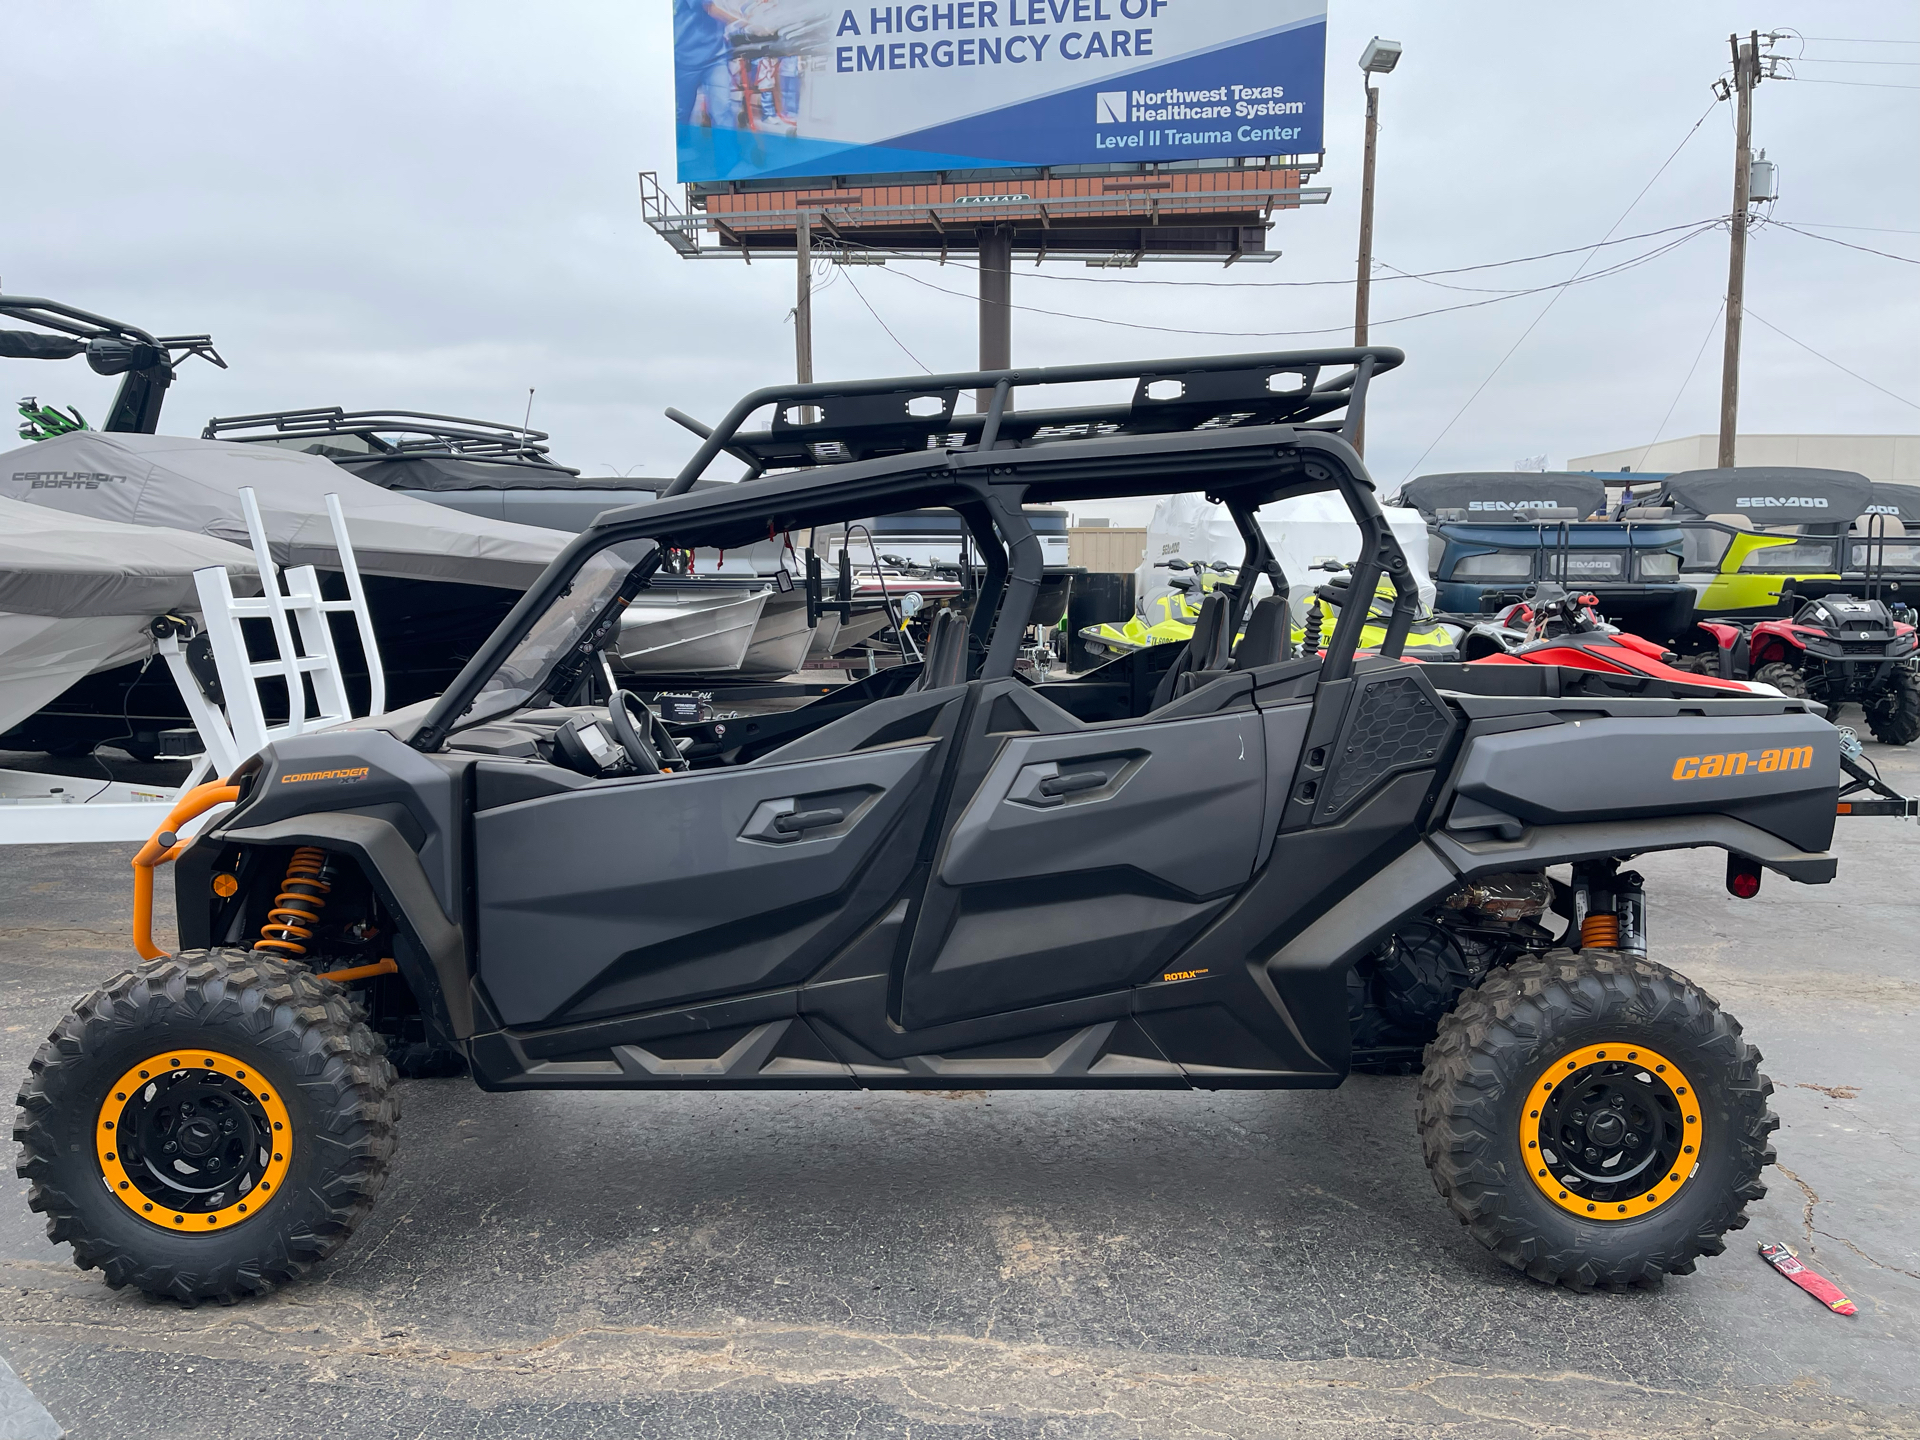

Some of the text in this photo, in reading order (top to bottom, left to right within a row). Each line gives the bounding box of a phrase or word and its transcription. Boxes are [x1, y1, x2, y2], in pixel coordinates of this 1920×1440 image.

[836, 0, 1168, 37] A HIGHER LEVEL OF
[836, 28, 1154, 73] EMERGENCY CARE
[1131, 84, 1284, 105] Northwest Texas
[1131, 101, 1304, 122] Healthcare System
[1096, 125, 1301, 148] Level II Trauma Center
[12, 471, 127, 483] CENTURION
[31, 480, 100, 490] BOATS
[1672, 746, 1814, 781] can-am
[281, 767, 369, 783] COMMANDER
[1618, 900, 1634, 938] FOX
[1163, 970, 1196, 982] ROTAX
